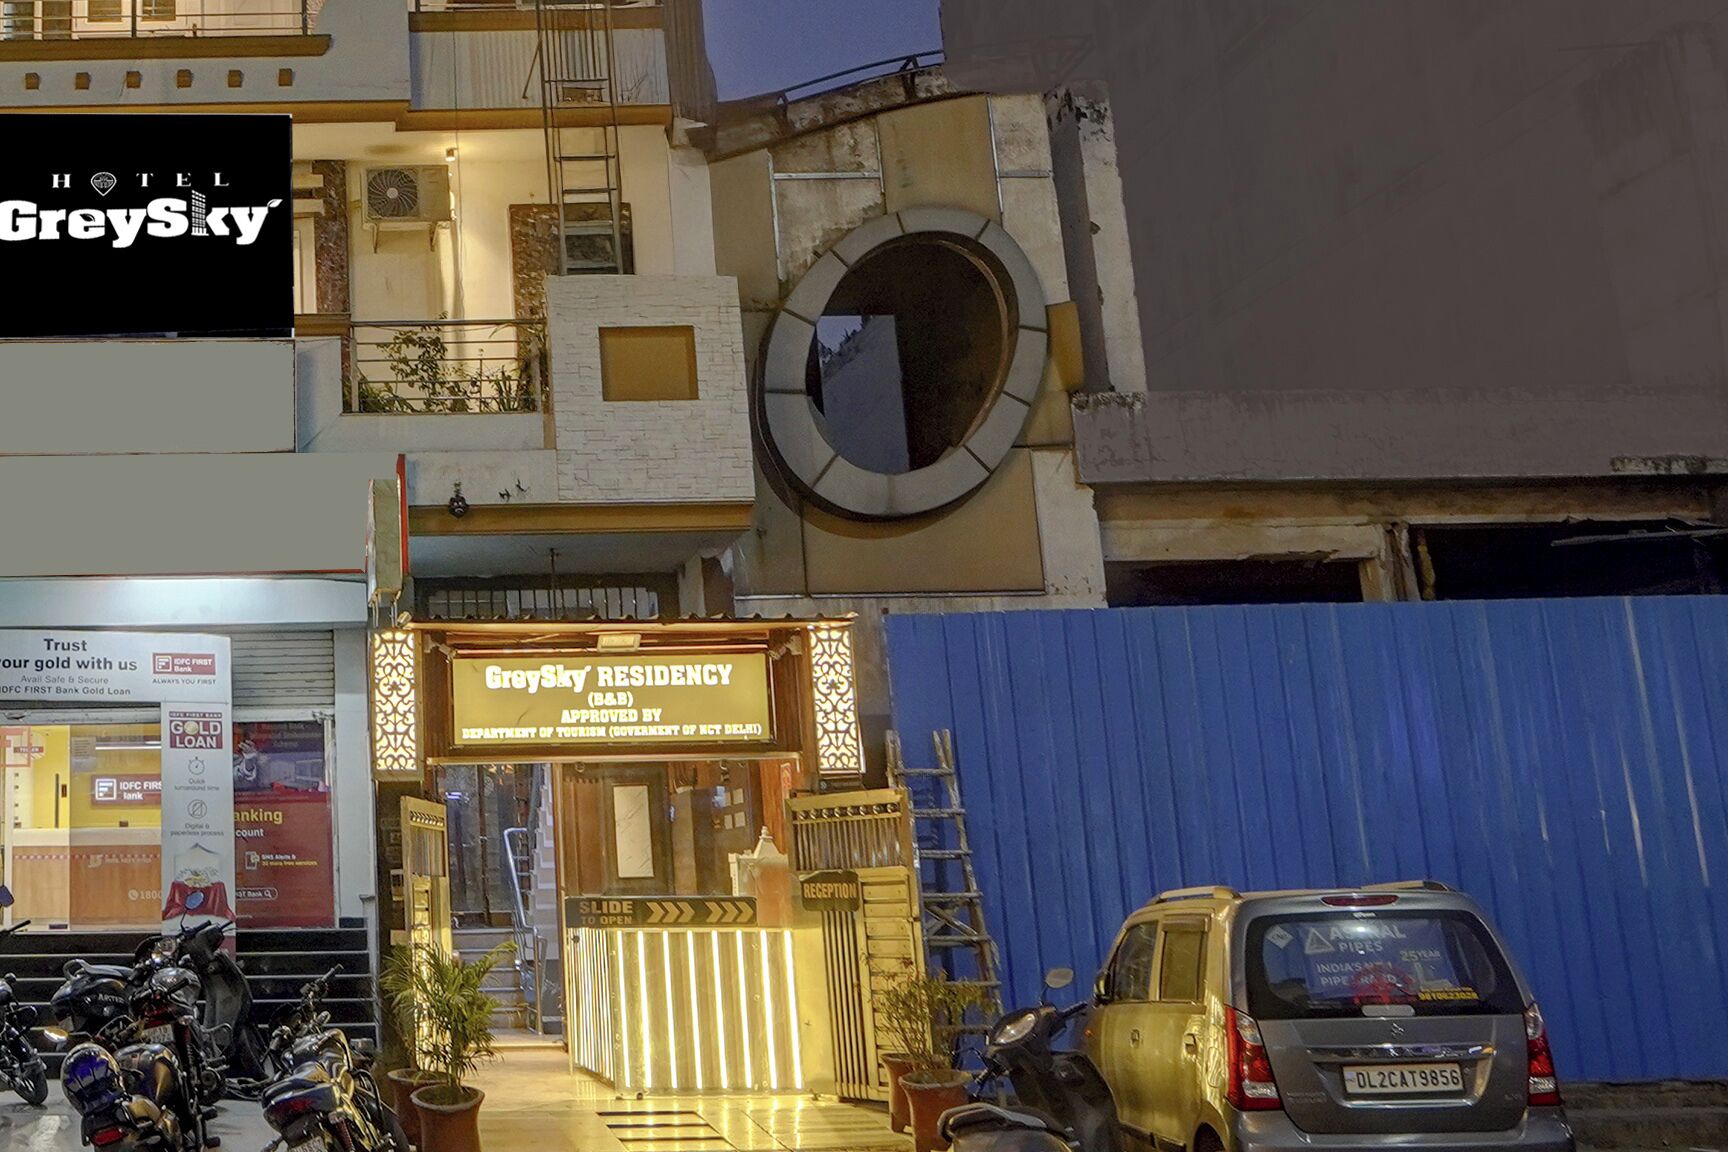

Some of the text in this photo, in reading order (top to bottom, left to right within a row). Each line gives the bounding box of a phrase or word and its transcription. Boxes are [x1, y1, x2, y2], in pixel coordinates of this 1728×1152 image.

[51, 171, 230, 196] HOTEL
[44, 638, 88, 652] Trust
[34, 656, 71, 672] gold
[76, 656, 113, 670] with
[118, 661, 138, 671] us
[173, 657, 213, 666] IDFC FIRST
[174, 665, 192, 673] Bank
[20, 675, 43, 684] Avail
[44, 675, 67, 684] Safe
[77, 675, 109, 684] Secure
[485, 664, 732, 694] GreySky RESIDENCY
[24, 685, 52, 694] FIRST
[56, 686, 80, 695] Bank
[82, 686, 105, 695] Gold
[107, 686, 131, 695] Loan
[587, 691, 633, 707] (B&B)
[561, 708, 662, 724] APPROVED BY
[170, 720, 221, 735] GOLD
[462, 726, 537, 740] DEPARTMENT
[539, 726, 554, 738] OF
[556, 726, 607, 739] TOURISM
[682, 724, 696, 737] OF
[699, 724, 722, 736] NCT
[724, 723, 762, 736] DELHI)
[176, 736, 217, 748] LOAN
[119, 781, 141, 790] IDFC
[803, 883, 857, 899] RECEPTION
[579, 900, 633, 914] SLIDE
[581, 915, 633, 925] TO OPEN
[1338, 941, 1383, 953] PIPES
[1357, 1069, 1460, 1088] DL2CAT9856
